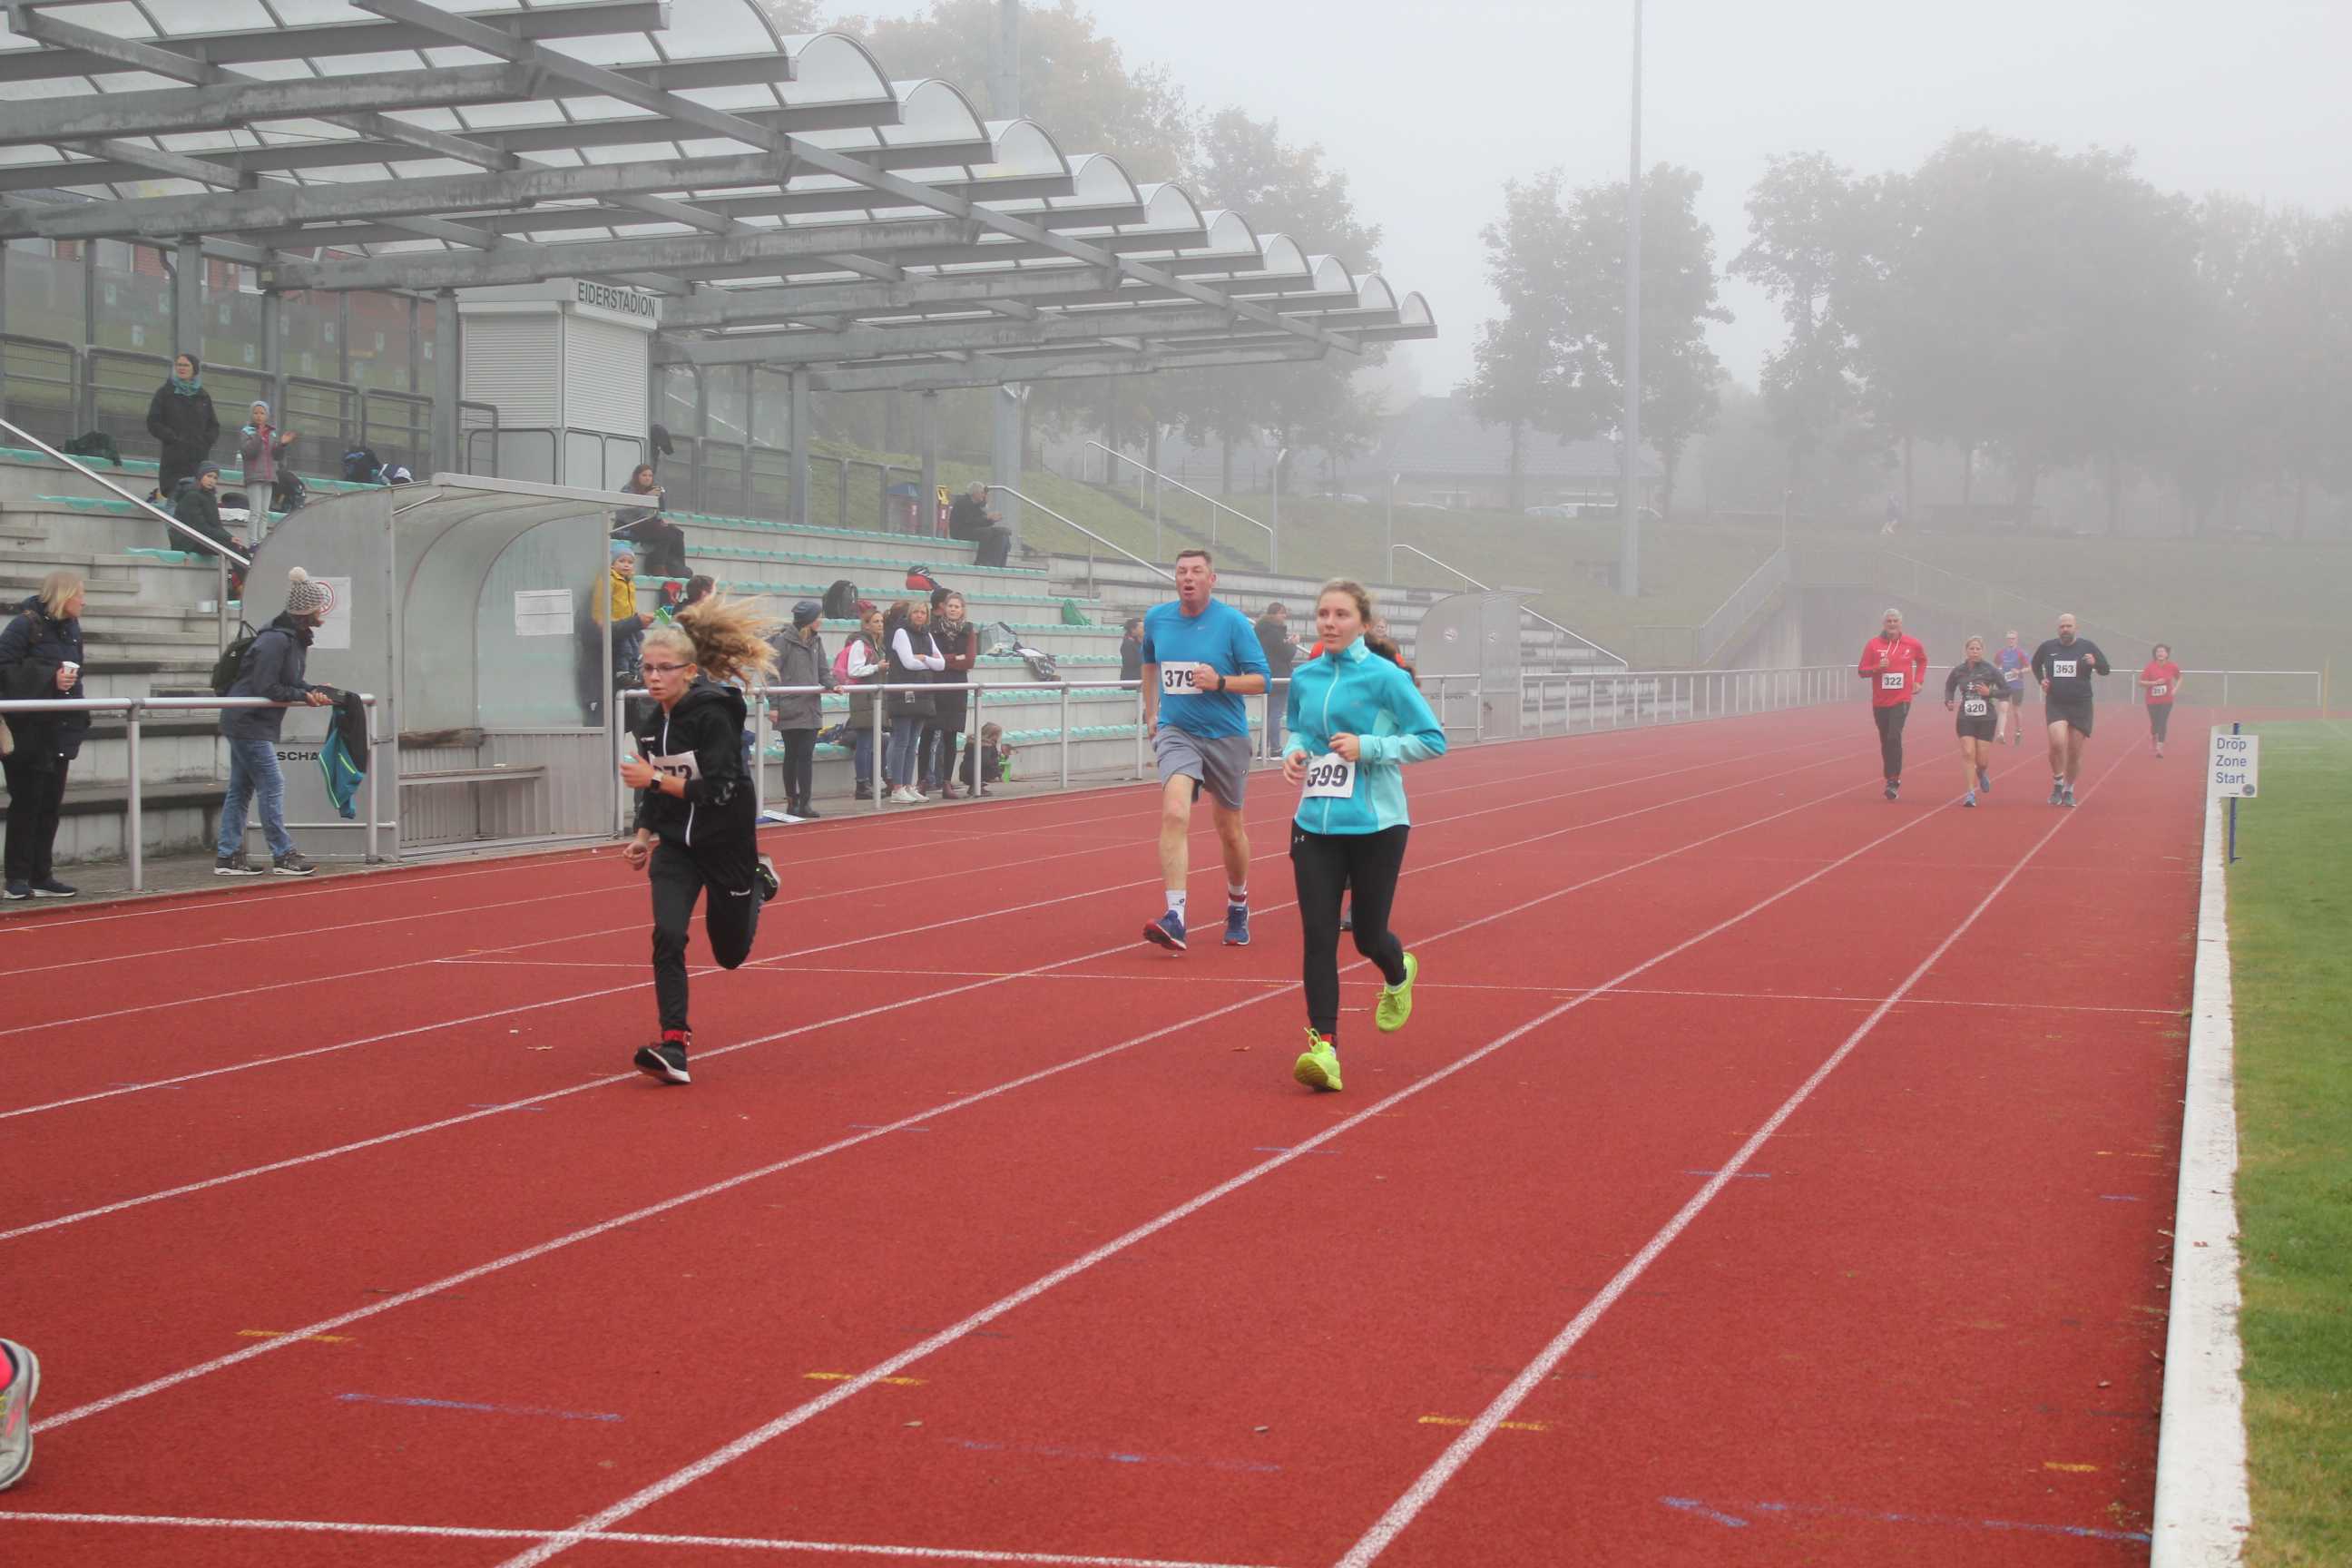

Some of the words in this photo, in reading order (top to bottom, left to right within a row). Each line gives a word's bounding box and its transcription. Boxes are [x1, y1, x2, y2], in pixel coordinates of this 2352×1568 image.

[578, 281, 655, 318] EIDERSTADION
[2055, 664, 2074, 673] 363
[1164, 670, 1196, 687] 379
[1883, 676, 1903, 686] 322
[1965, 703, 1984, 713] 320
[2217, 737, 2247, 752] Drop
[2215, 754, 2248, 767] Zone
[1307, 764, 1348, 788] 399
[2216, 771, 2246, 784] Start
